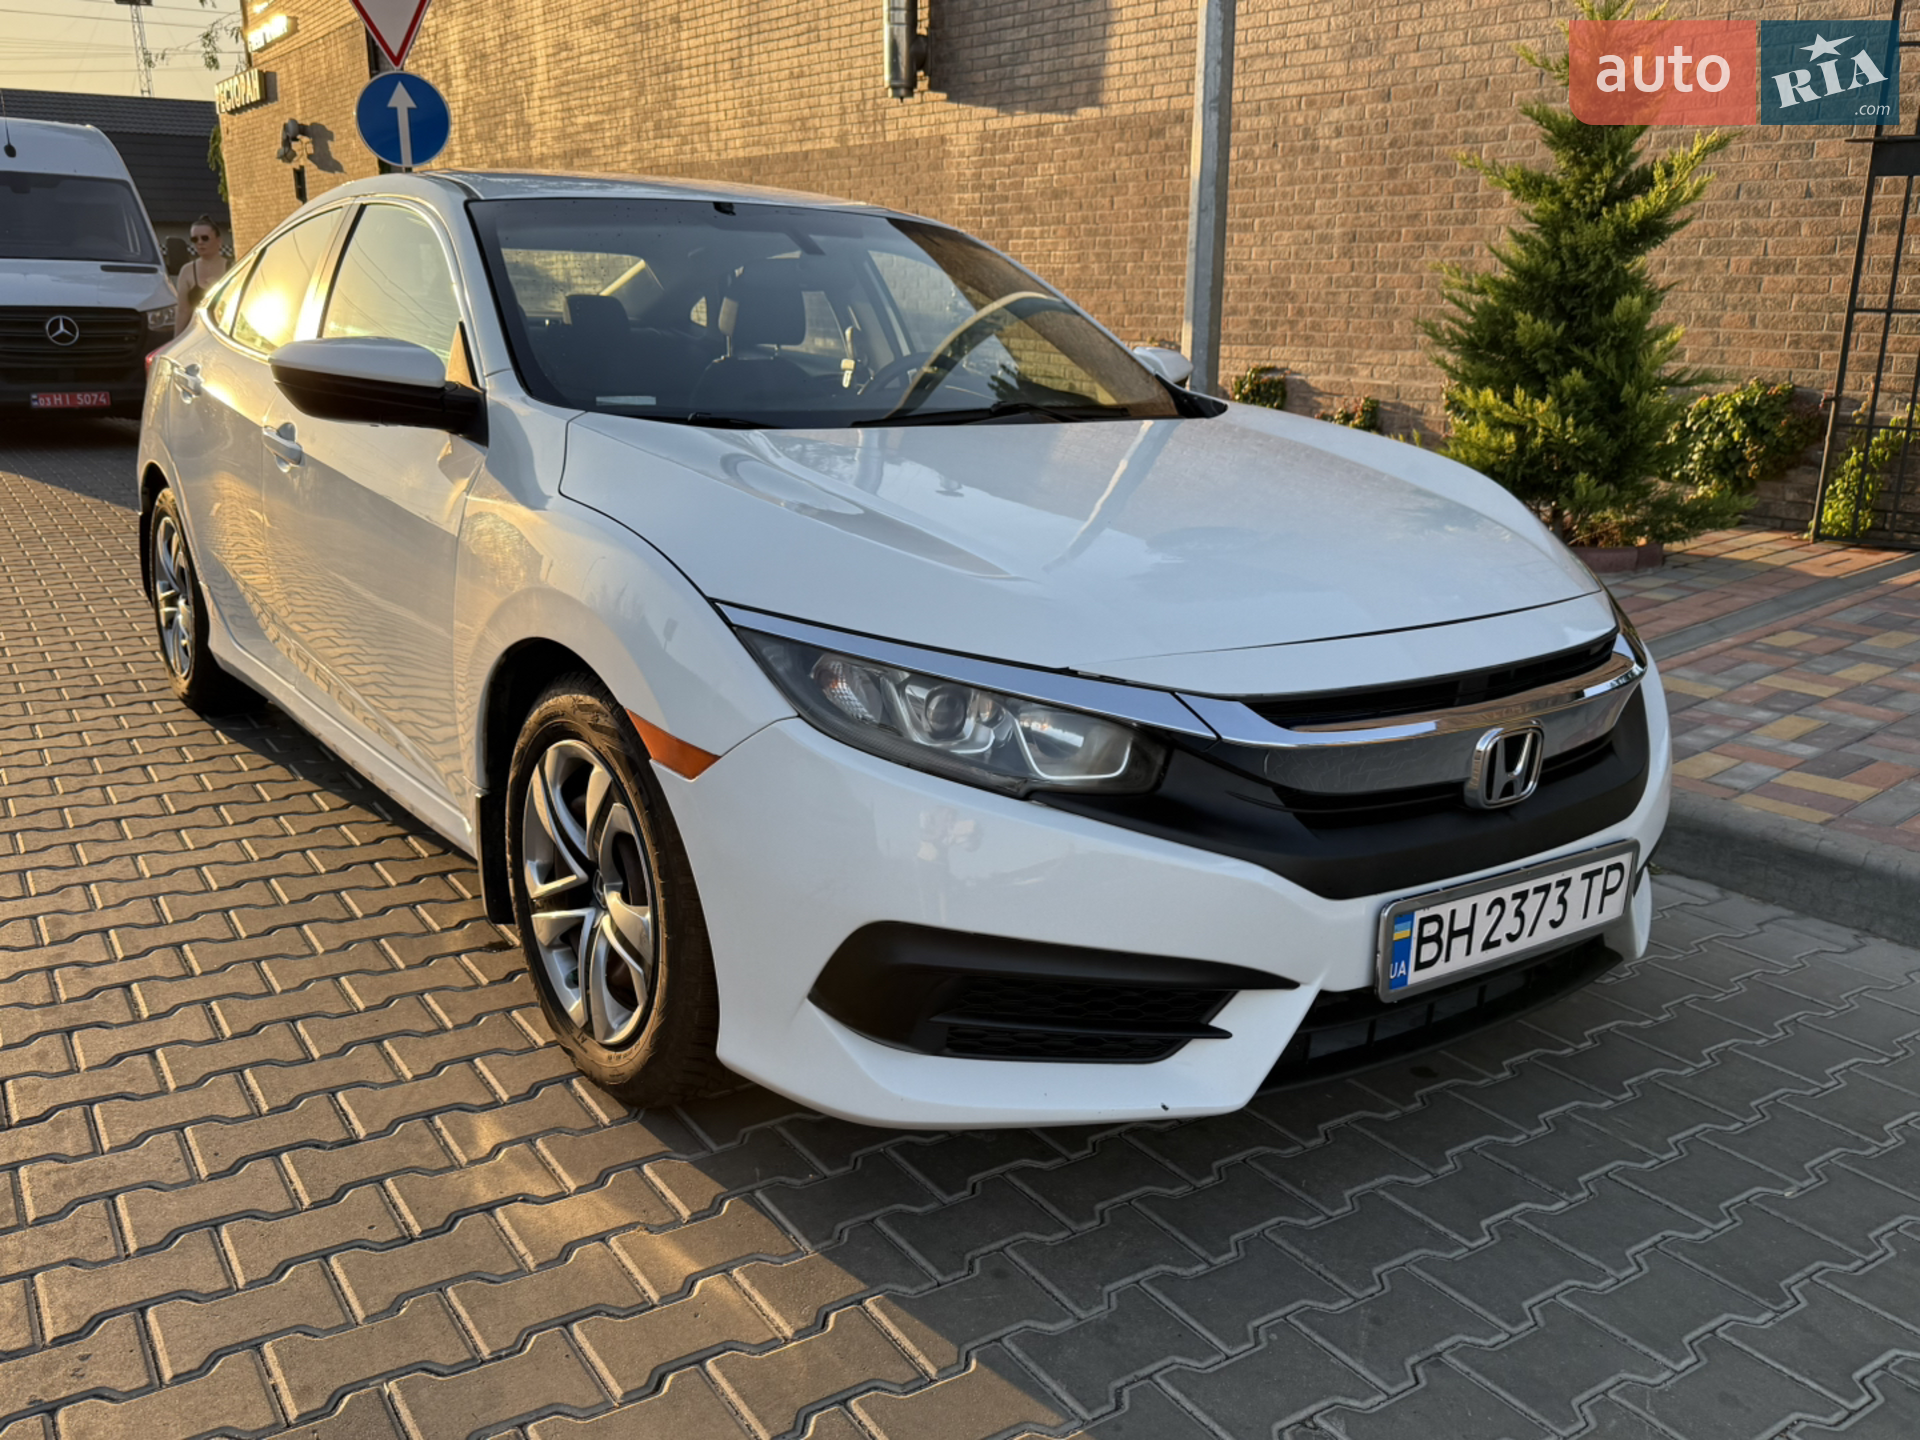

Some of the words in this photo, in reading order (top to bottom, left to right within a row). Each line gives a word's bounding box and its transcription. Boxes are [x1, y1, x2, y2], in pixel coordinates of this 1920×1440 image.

[77, 393, 107, 405] 5074
[1414, 903, 1477, 972] BH
[1481, 877, 1572, 951] 2373
[1581, 862, 1625, 920] TP
[1389, 960, 1406, 979] UA
